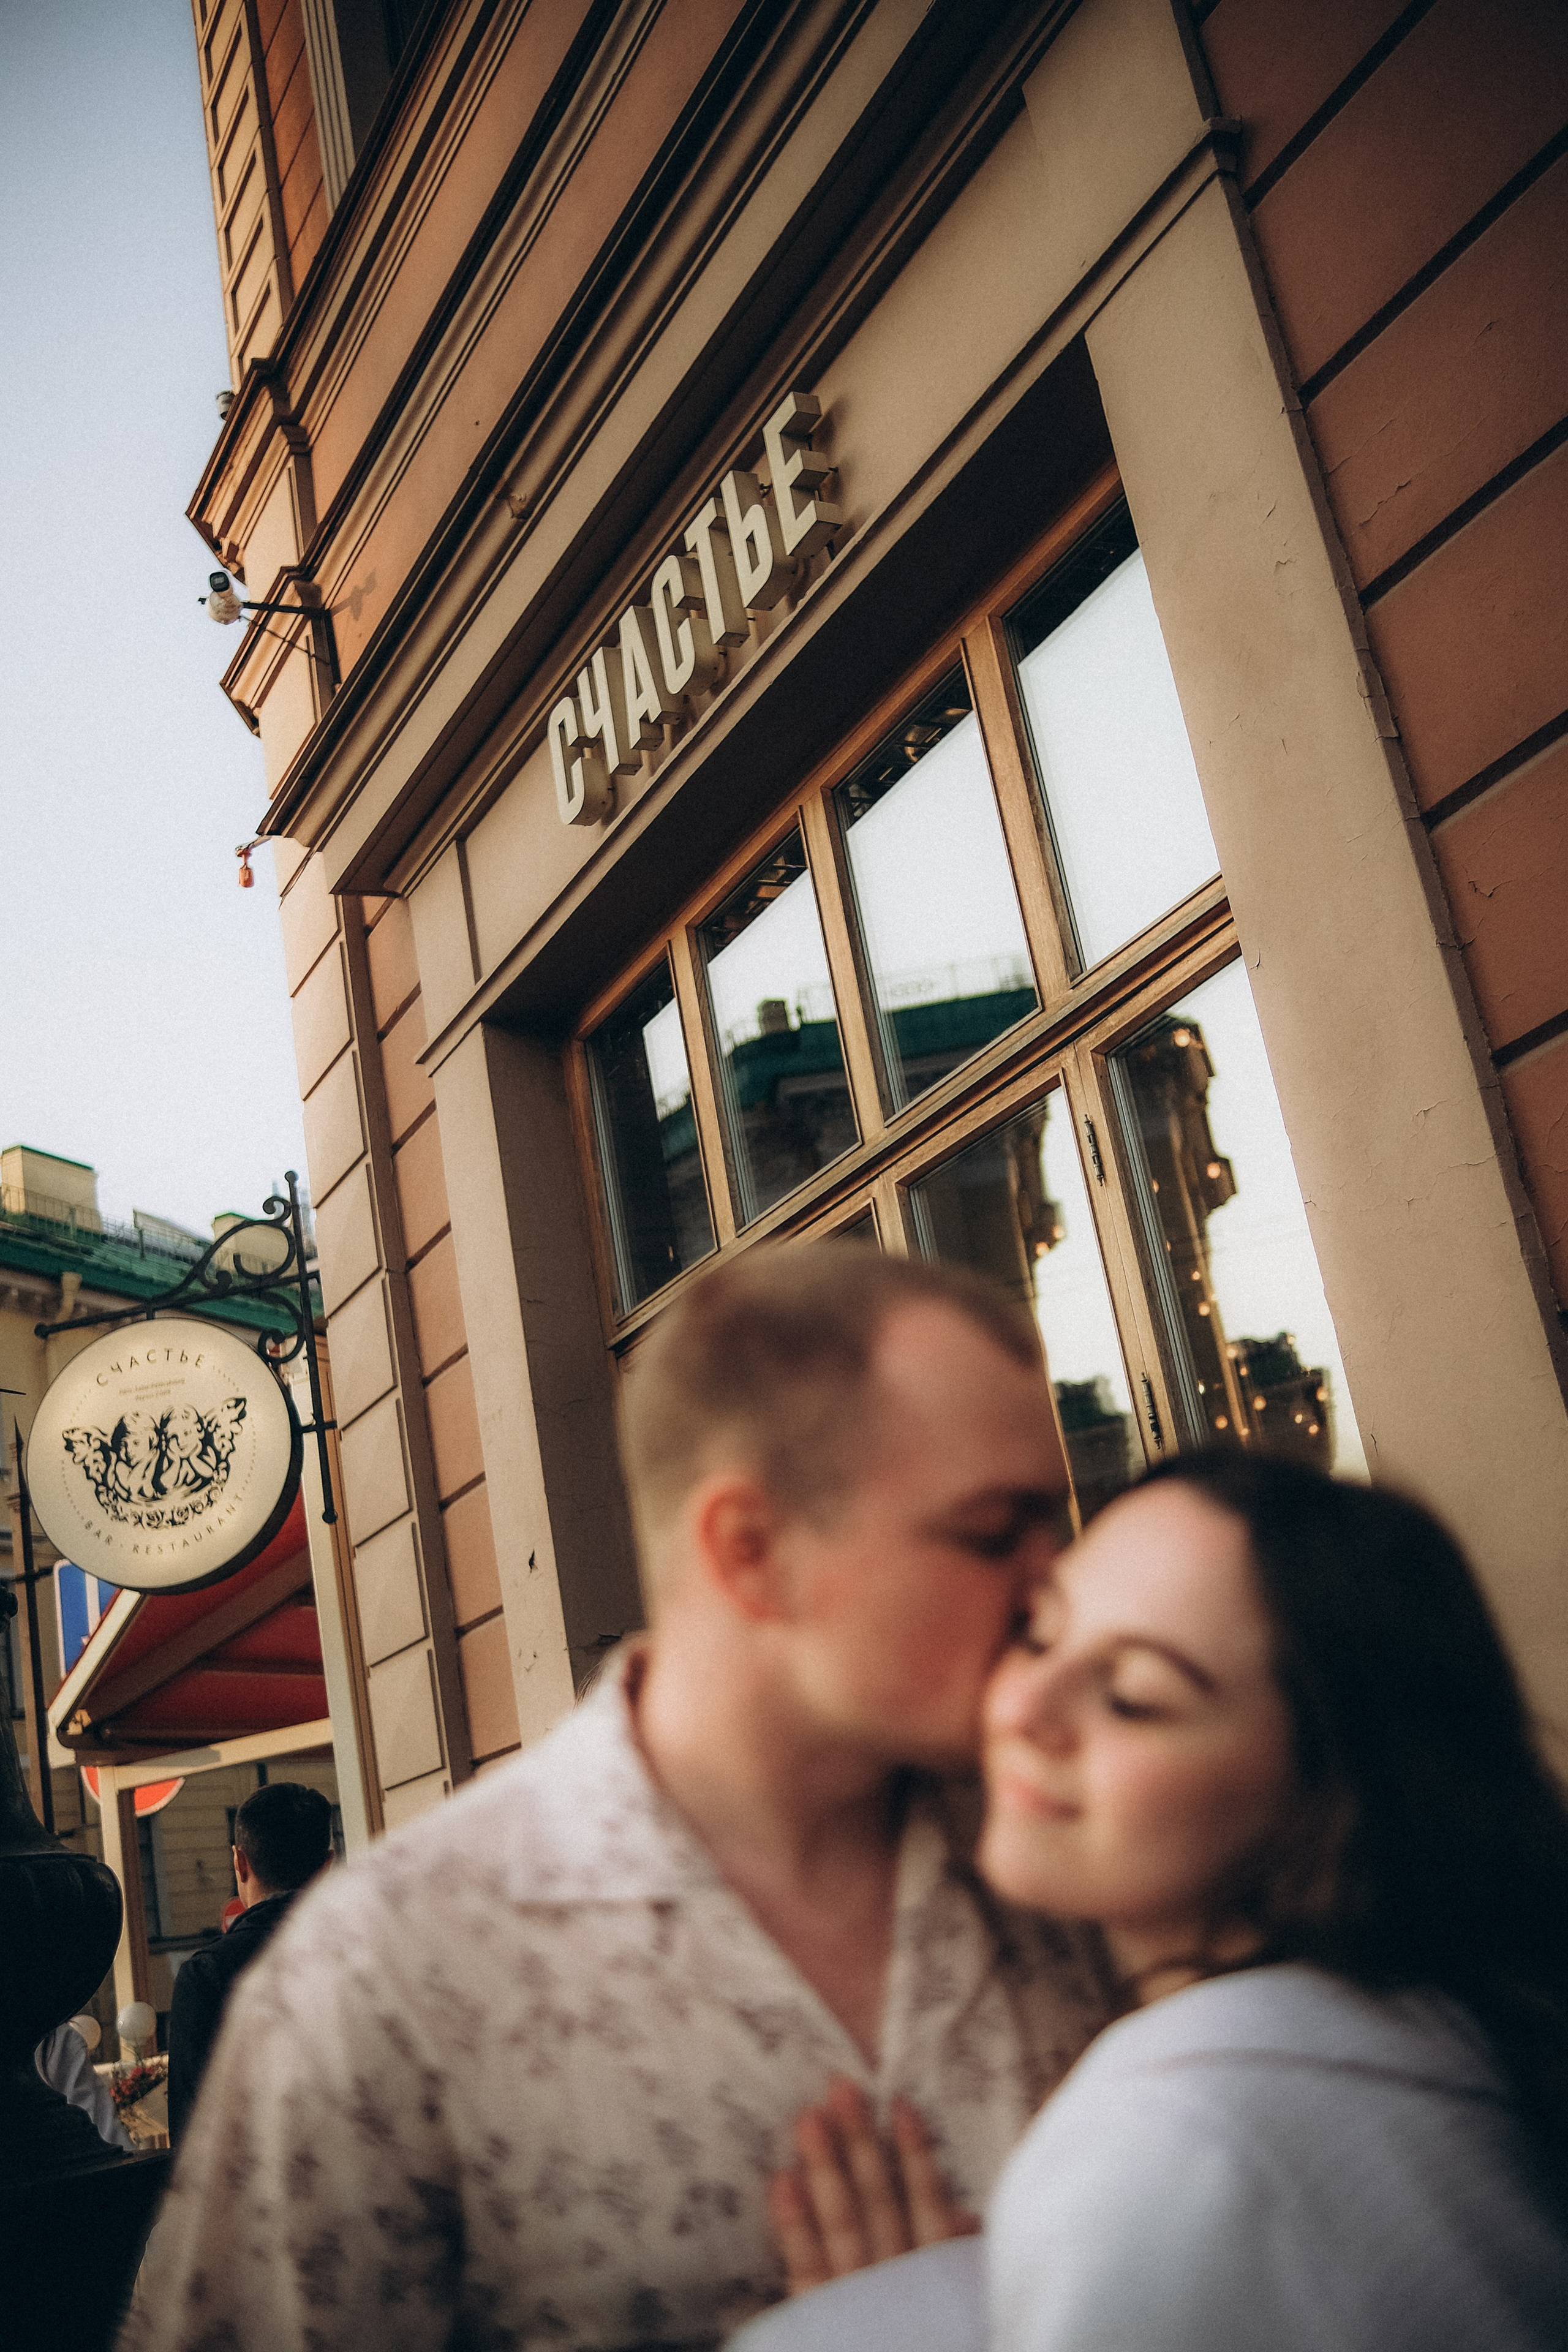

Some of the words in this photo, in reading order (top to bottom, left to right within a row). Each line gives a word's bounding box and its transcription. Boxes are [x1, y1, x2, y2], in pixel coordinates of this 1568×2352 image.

[547, 391, 822, 825] СЧАСТЬЕ
[96, 1349, 205, 1387] СЧАСТЬЕ
[85, 1520, 113, 1545] BAR
[132, 1494, 243, 1555] RESTAURANT
